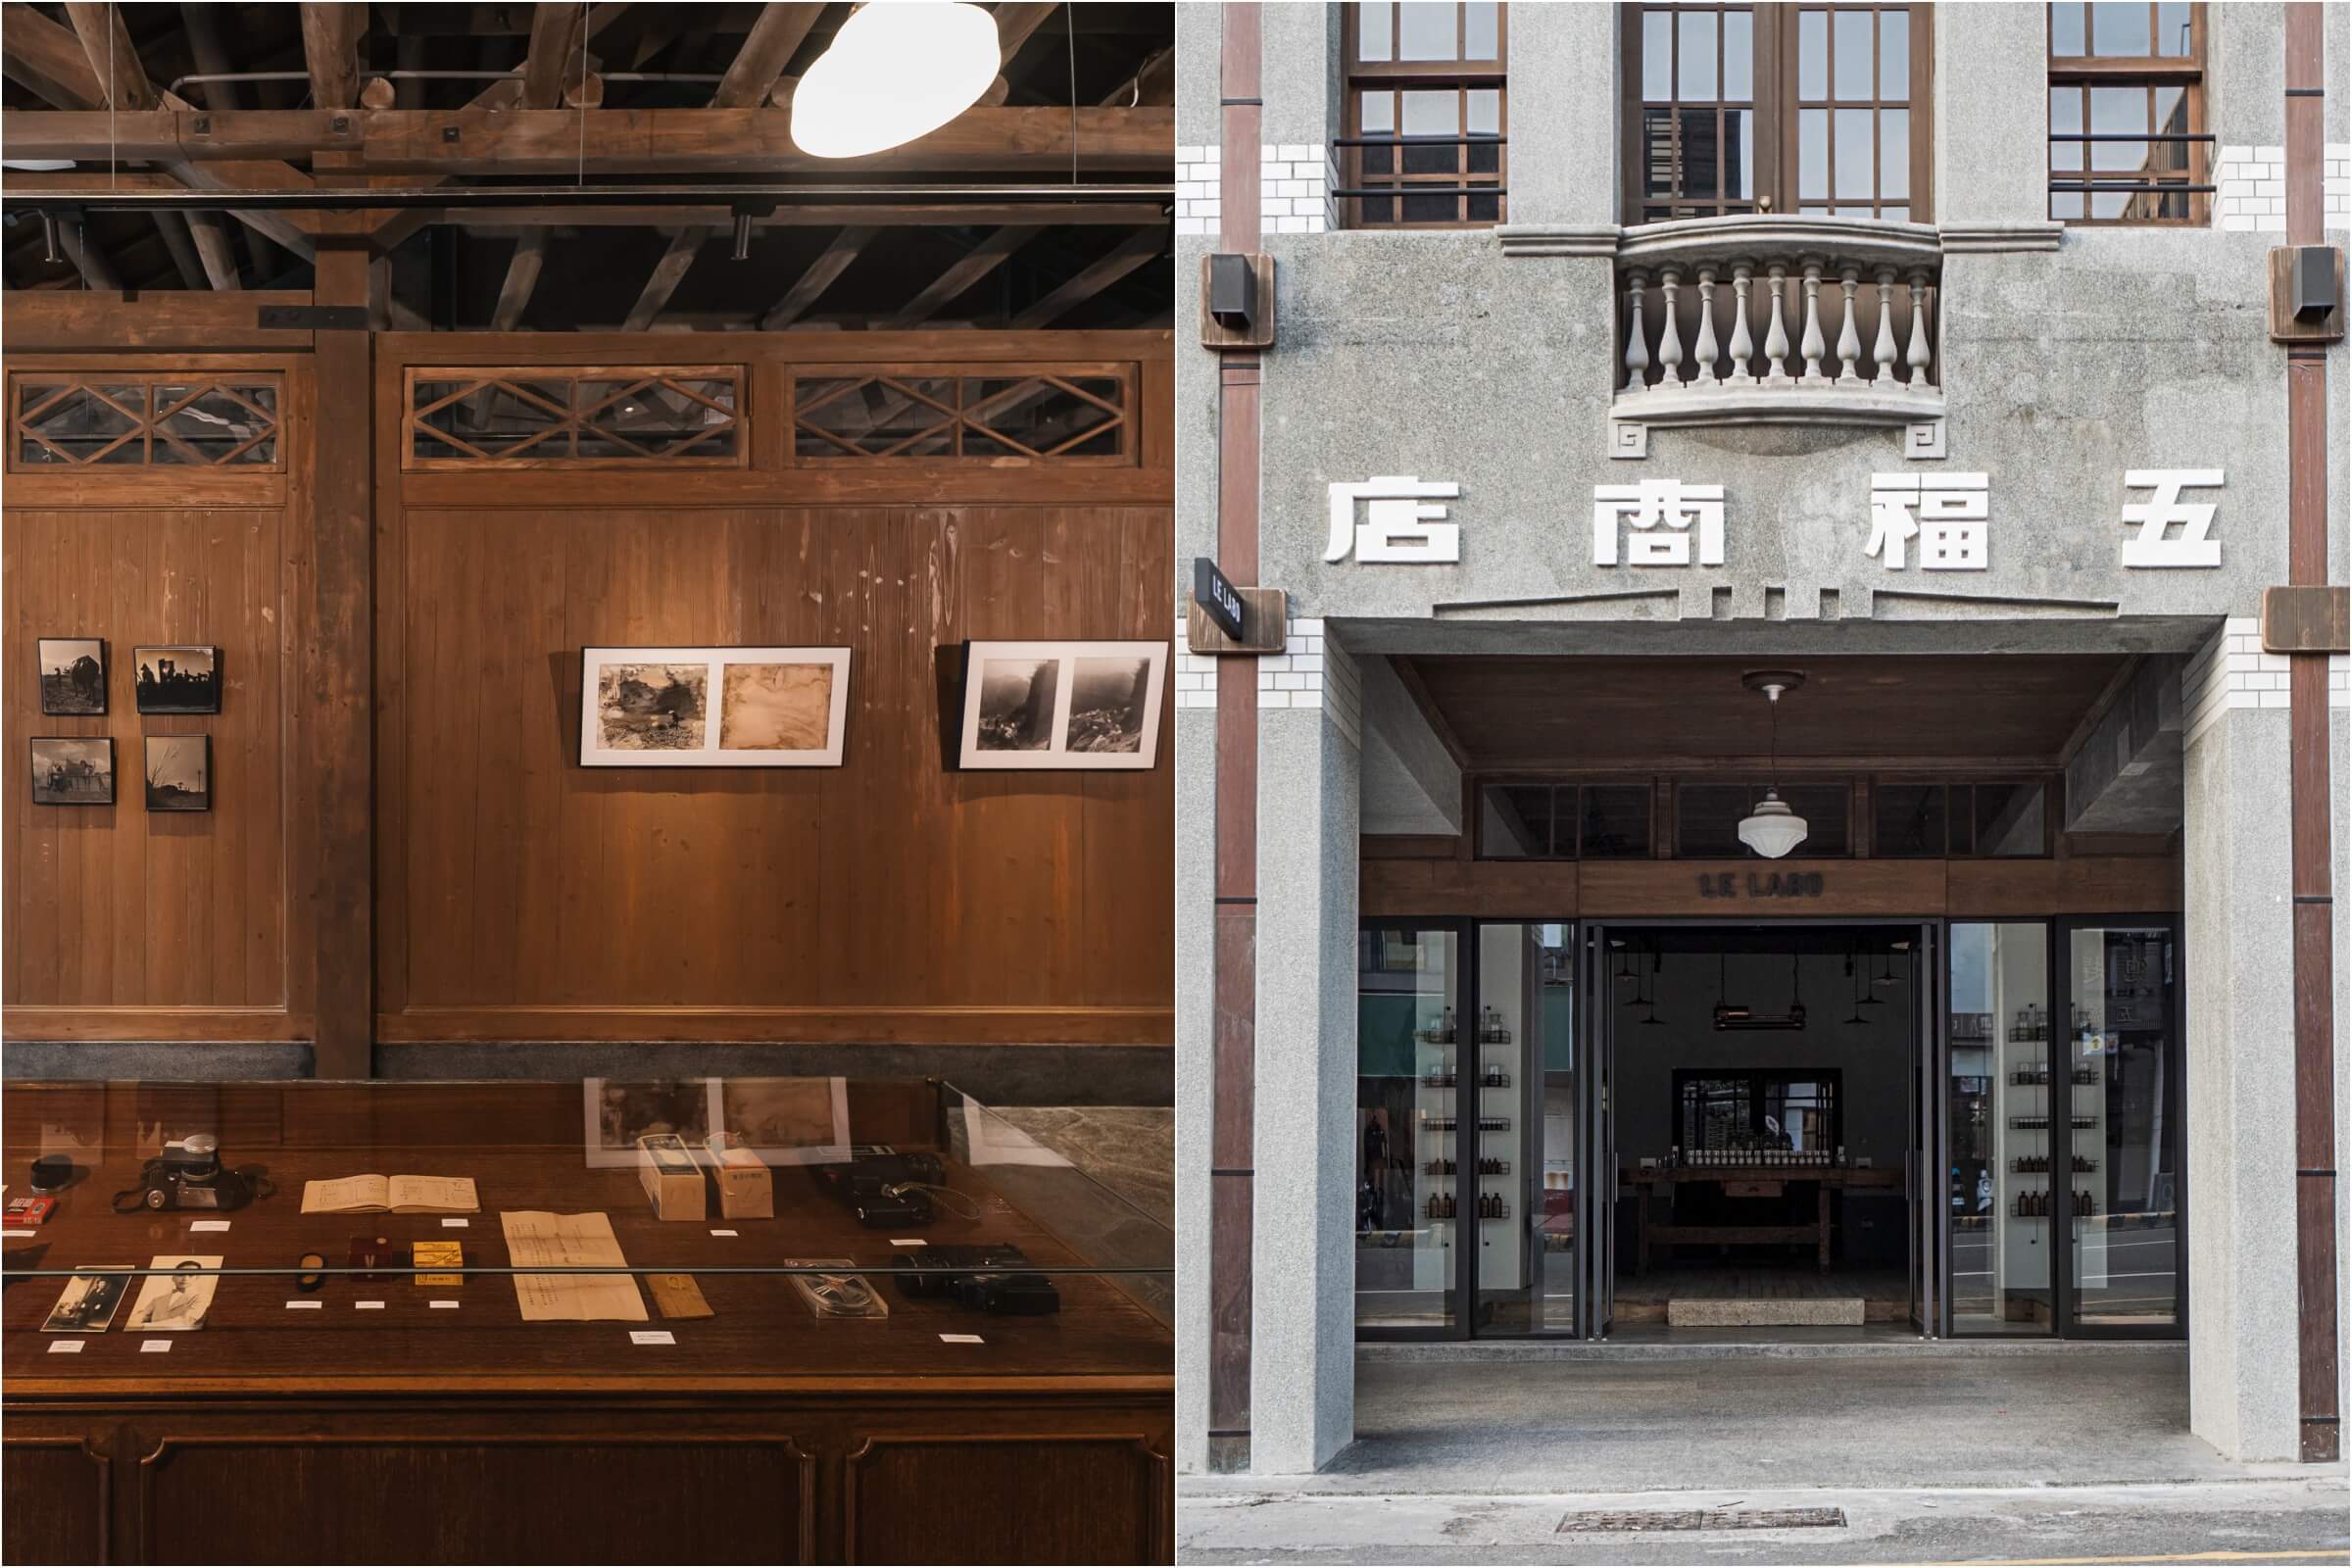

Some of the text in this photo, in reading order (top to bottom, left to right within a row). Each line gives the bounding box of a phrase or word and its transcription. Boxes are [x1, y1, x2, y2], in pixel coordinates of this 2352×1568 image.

[1323, 469, 2225, 569] 五福商店
[1700, 871, 1824, 898] LE LABO
